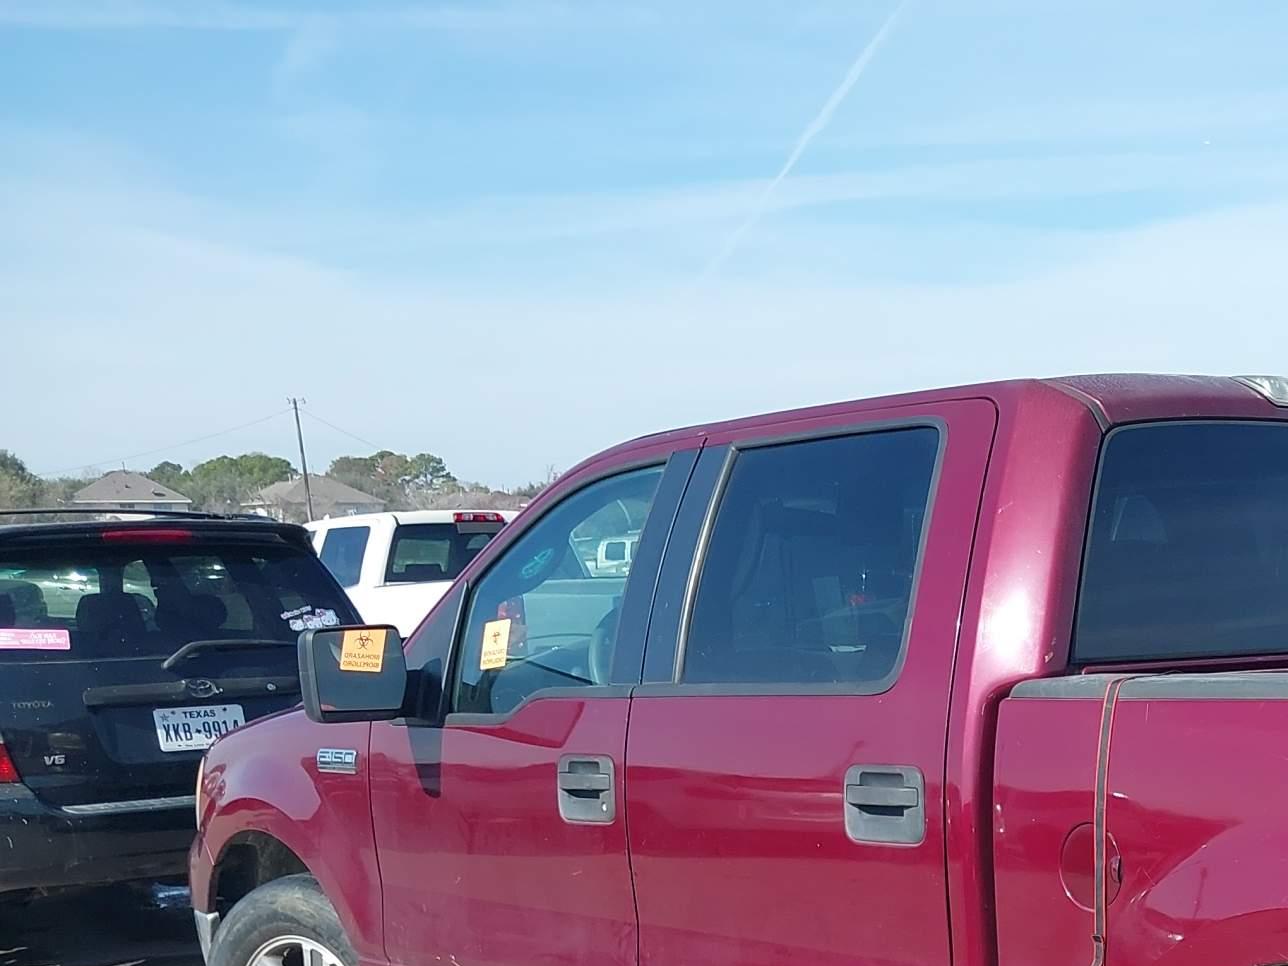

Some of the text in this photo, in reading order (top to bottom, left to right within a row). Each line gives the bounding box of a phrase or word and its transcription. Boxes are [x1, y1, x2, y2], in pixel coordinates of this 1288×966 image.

[12, 701, 53, 710] TOYOTA
[182, 709, 217, 719] TEXAS
[44, 754, 66, 766] V6
